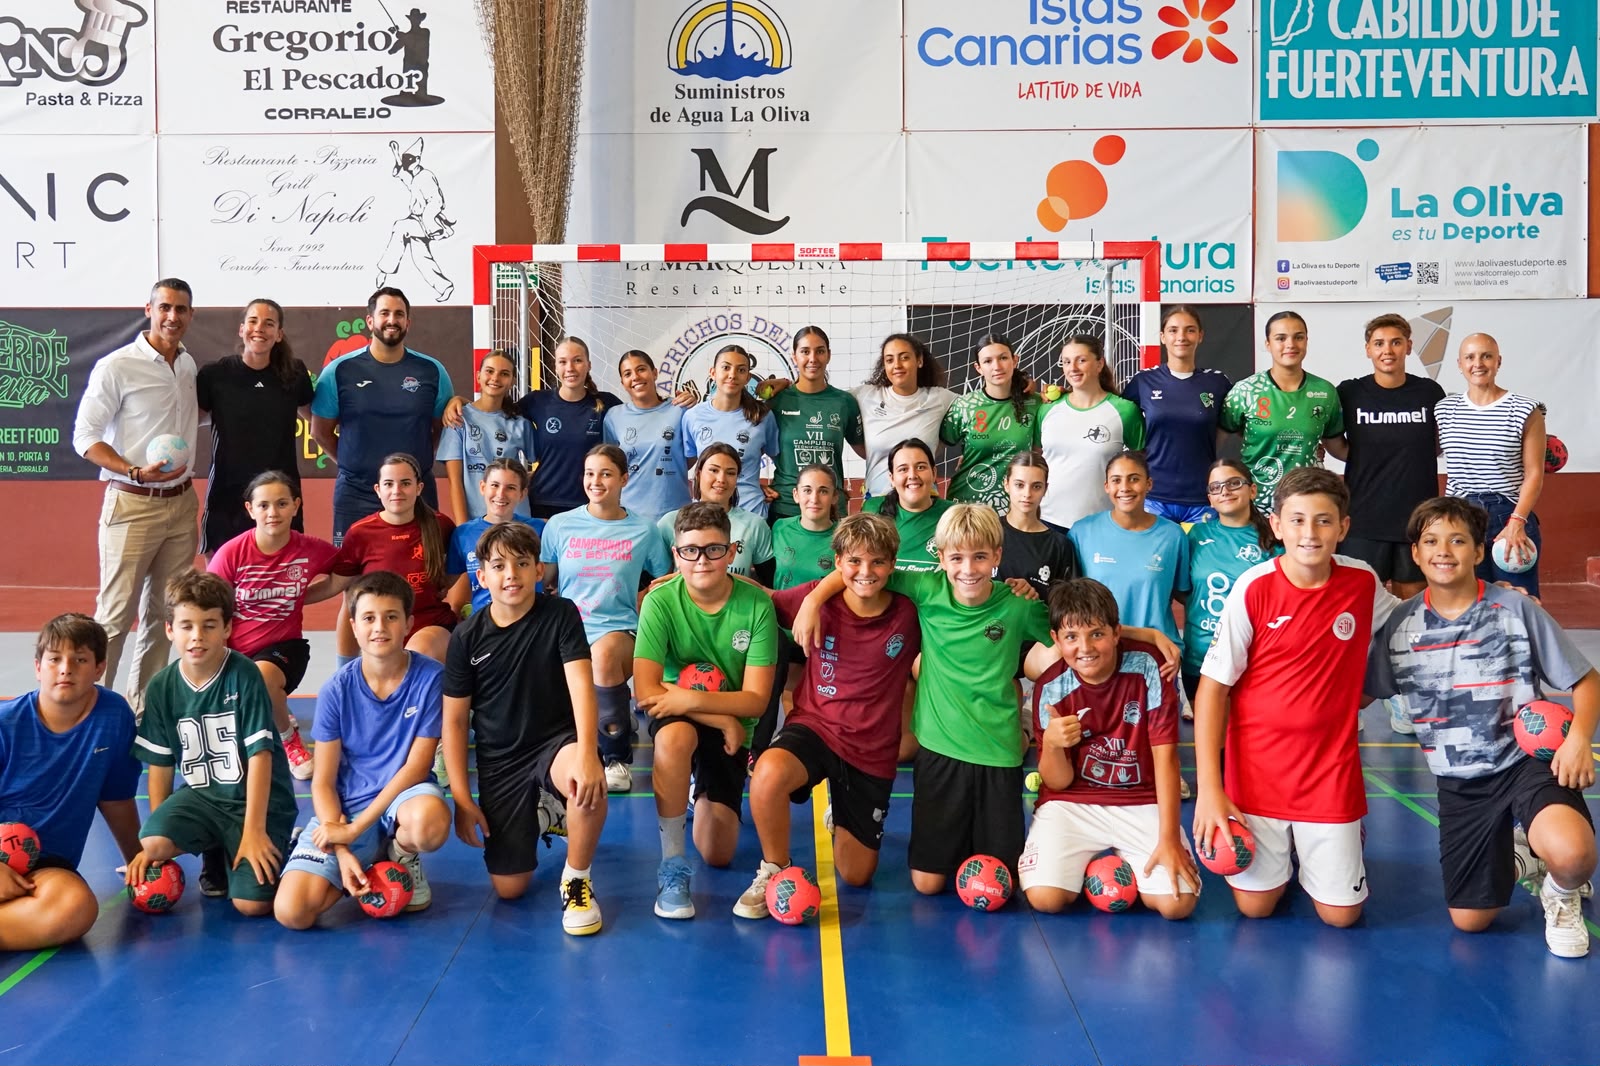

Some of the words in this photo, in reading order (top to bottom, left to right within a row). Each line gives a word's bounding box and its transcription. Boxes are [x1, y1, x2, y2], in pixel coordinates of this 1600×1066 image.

[226, 0, 352, 14] RESTAURANTE
[1327, 0, 1497, 39] CABILDO
[1511, 0, 1560, 37] DE
[212, 22, 394, 61] Gregorio
[917, 26, 1143, 67] Canarias
[243, 67, 274, 91] El
[282, 66, 421, 92] Pescador
[1266, 46, 1588, 99] FUERTEVENTURA
[26, 92, 74, 106] Pasta
[80, 92, 92, 106] &
[98, 92, 143, 106] Pizza
[674, 83, 786, 100] Suministros
[1018, 81, 1079, 100] LATITUD
[1085, 82, 1102, 98] DE
[1107, 81, 1142, 99] VIDA
[264, 107, 392, 120] CORRALEJO
[650, 107, 671, 123] de
[677, 106, 724, 126] Agua
[731, 106, 754, 123] La
[761, 106, 810, 123] Oliva
[202, 146, 299, 166] Restaurante
[313, 145, 378, 171] Pizzeria
[265, 170, 318, 197] Grill
[1391, 187, 1438, 218] La
[1453, 182, 1563, 218] Oliva
[210, 190, 260, 224] Di
[271, 192, 376, 235] Napoli
[1392, 228, 1411, 241] es
[1418, 226, 1436, 241] tu
[1443, 222, 1540, 243] Deporte
[259, 236, 294, 252] Since
[298, 243, 325, 252] 1992
[217, 255, 269, 275] Corralejo
[283, 255, 365, 271] Fuerteventura
[1335, 262, 1360, 270] Deporte
[1454, 259, 1567, 268] www.laolivaestudeporte.es
[1293, 279, 1358, 287] #laolivaestudeporte
[1454, 269, 1538, 278] www.visitcorralejo.com
[1454, 278, 1509, 287] www.laoliva.es
[626, 281, 847, 295] Restaurante
[1086, 276, 1135, 294] isas
[1160, 275, 1235, 293] anarias
[657, 313, 742, 394] APRICHOS
[0, 334, 70, 398] ERDE
[1286, 406, 1297, 419] 2
[1356, 406, 1427, 425] hummel
[998, 416, 1011, 431] 10
[28, 428, 59, 444] FOOD
[19, 452, 42, 462] PORTA
[45, 452, 50, 462] 9
[0, 465, 49, 473] ERIA_CORRALEJO
[176, 711, 244, 789] 25
